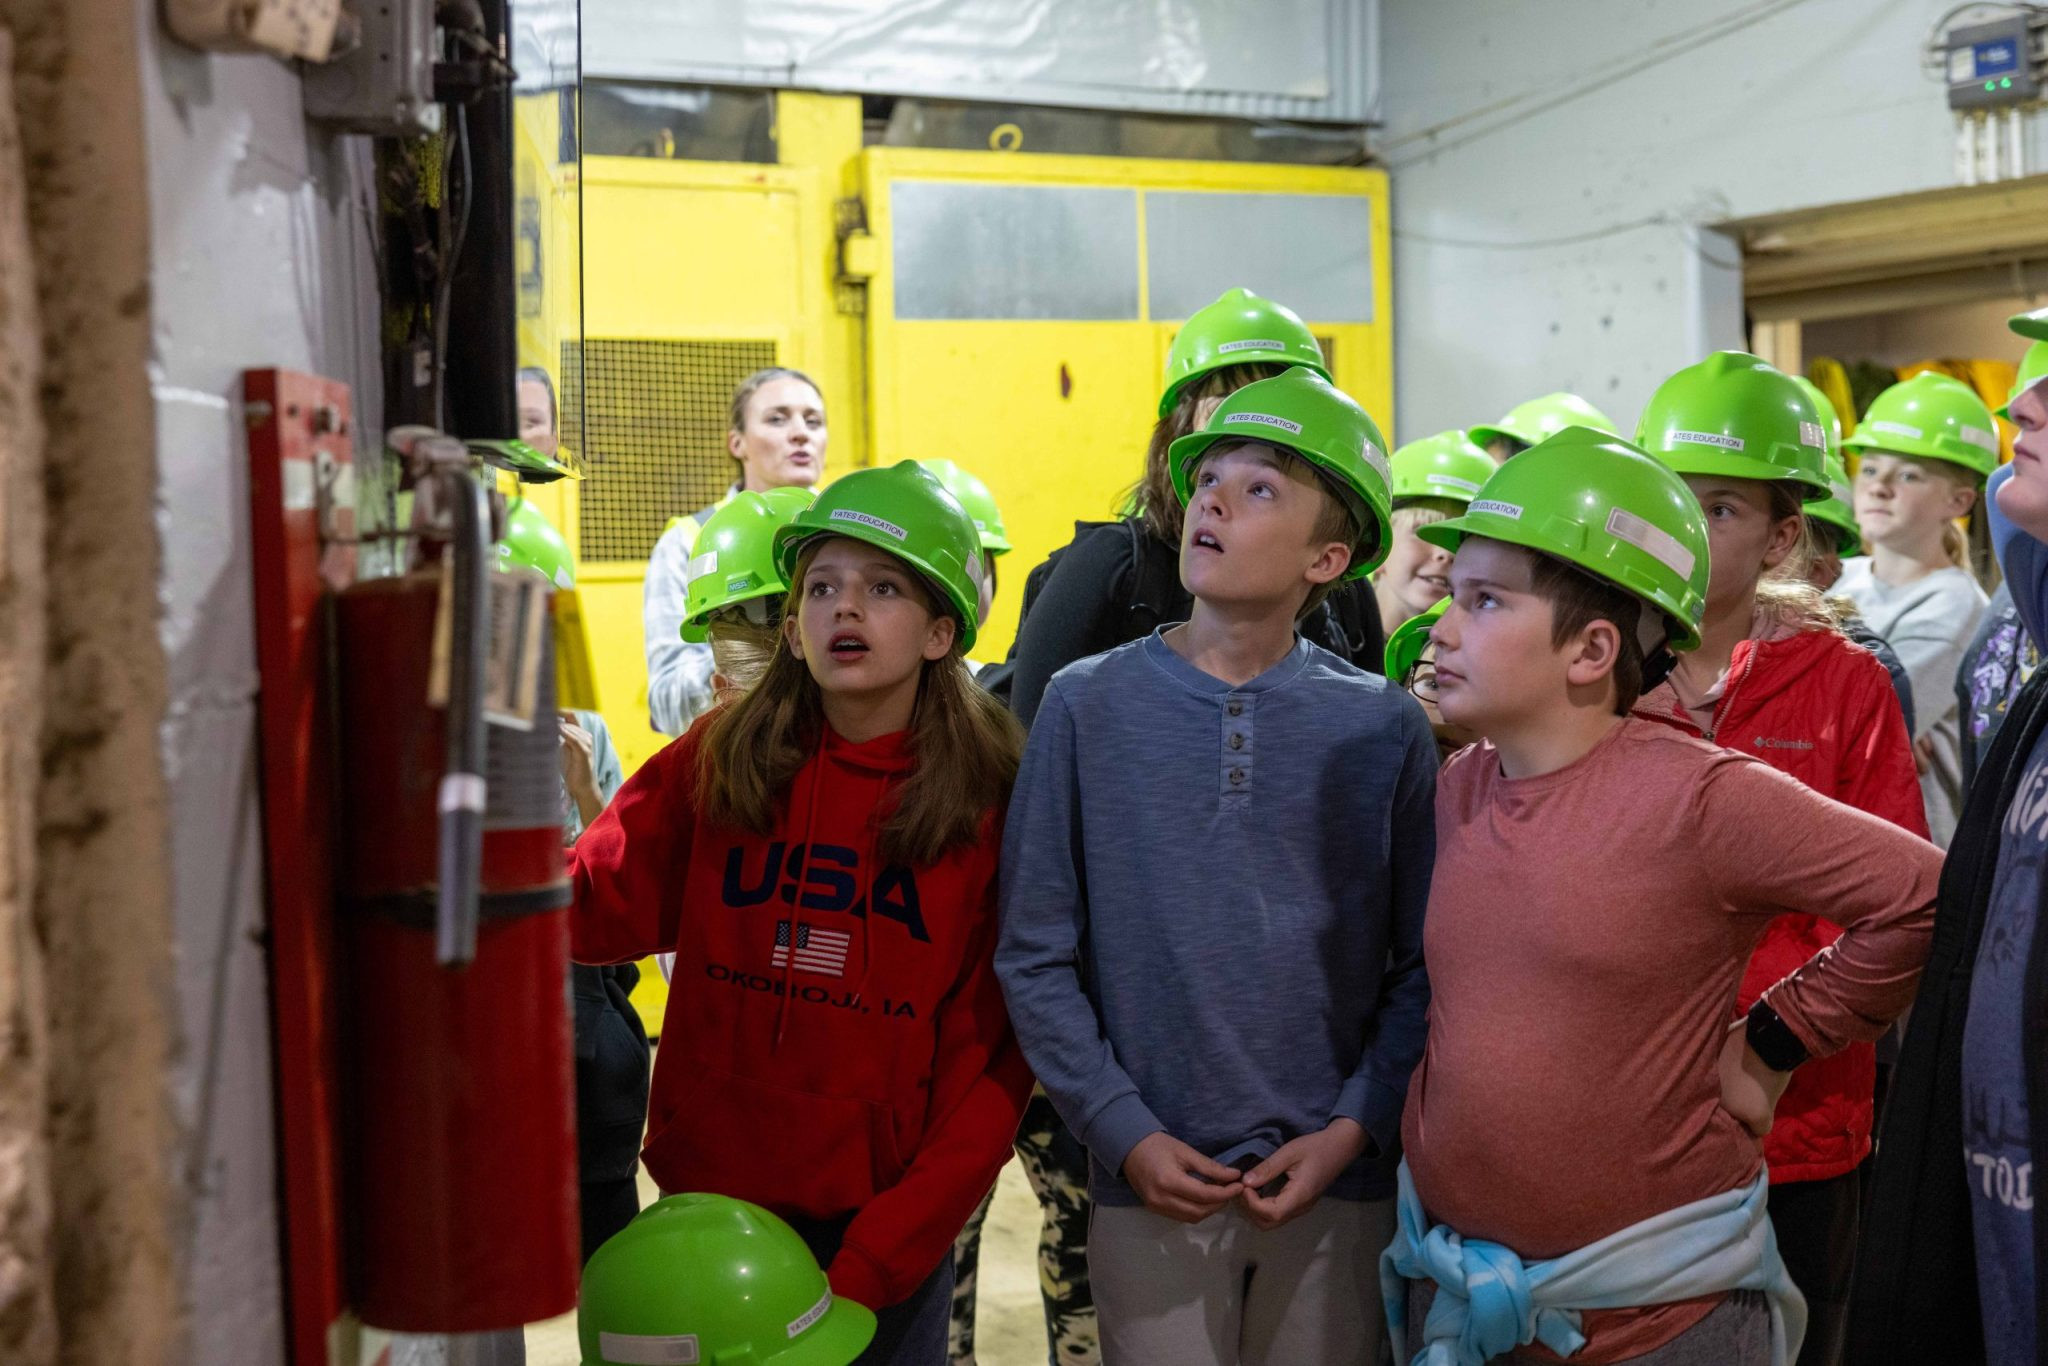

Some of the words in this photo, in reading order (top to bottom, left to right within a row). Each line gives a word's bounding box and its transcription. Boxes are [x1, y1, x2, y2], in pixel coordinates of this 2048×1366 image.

[1250, 414, 1298, 432] EDUCATION
[1693, 433, 1740, 448] EDUCATION
[834, 511, 857, 519] YATES
[857, 514, 904, 537] EDUCATION
[1765, 737, 1814, 750] Columbia
[721, 842, 932, 944] USA
[882, 998, 917, 1019] IA
